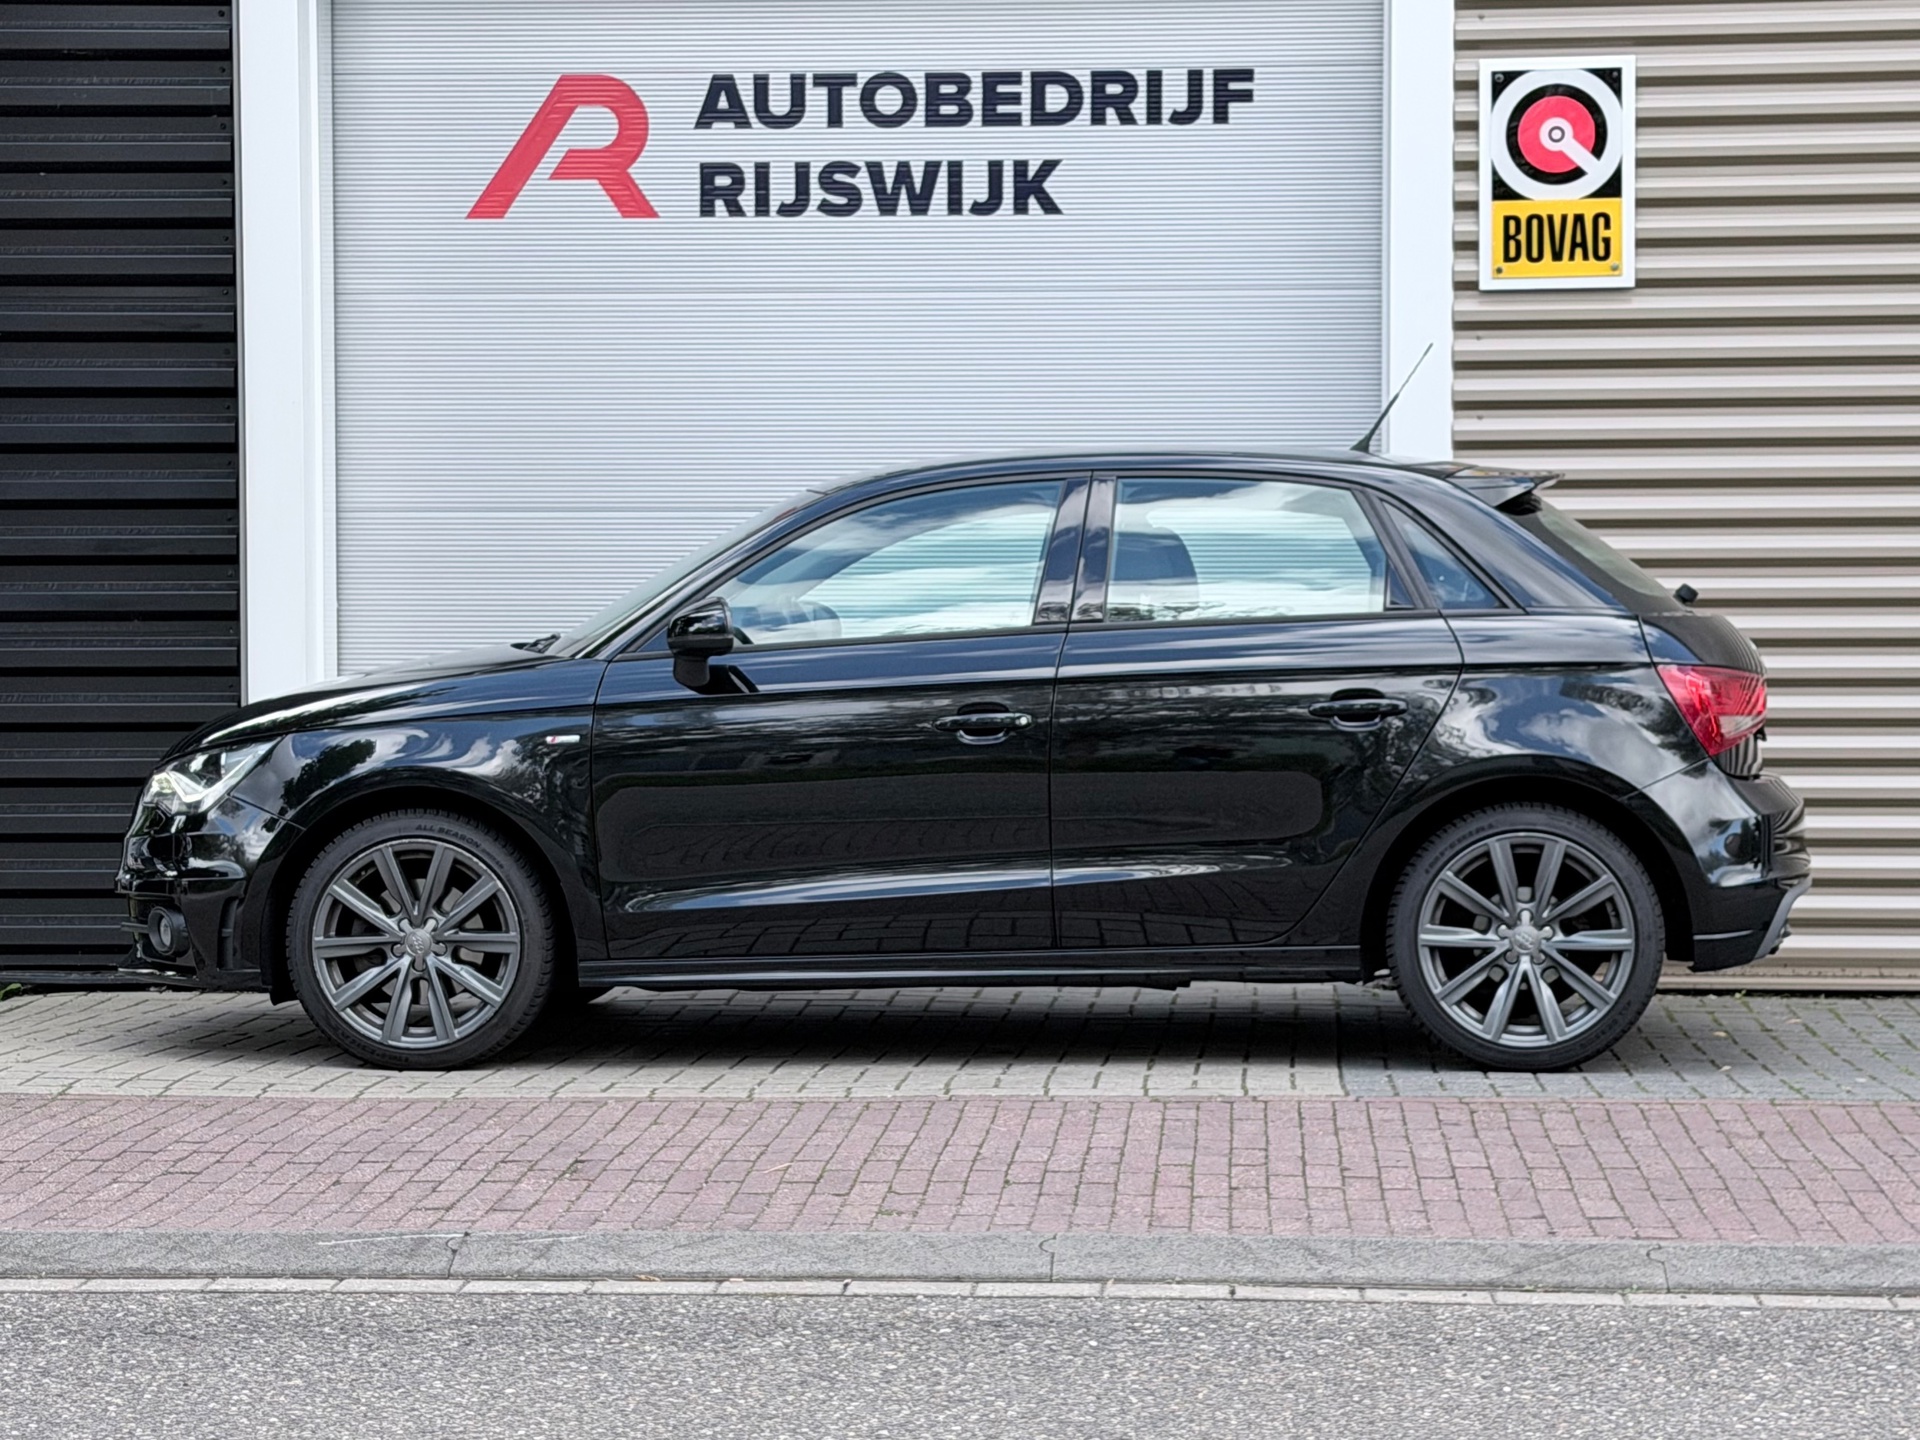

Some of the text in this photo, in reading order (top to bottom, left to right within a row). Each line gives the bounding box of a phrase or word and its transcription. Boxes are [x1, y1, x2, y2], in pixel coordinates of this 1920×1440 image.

[695, 68, 1255, 129] AUTOBEDRIJF
[700, 159, 1063, 217] RIJSWIJK
[1503, 212, 1611, 264] BOVAG
[415, 824, 481, 849] ALL SEASON
